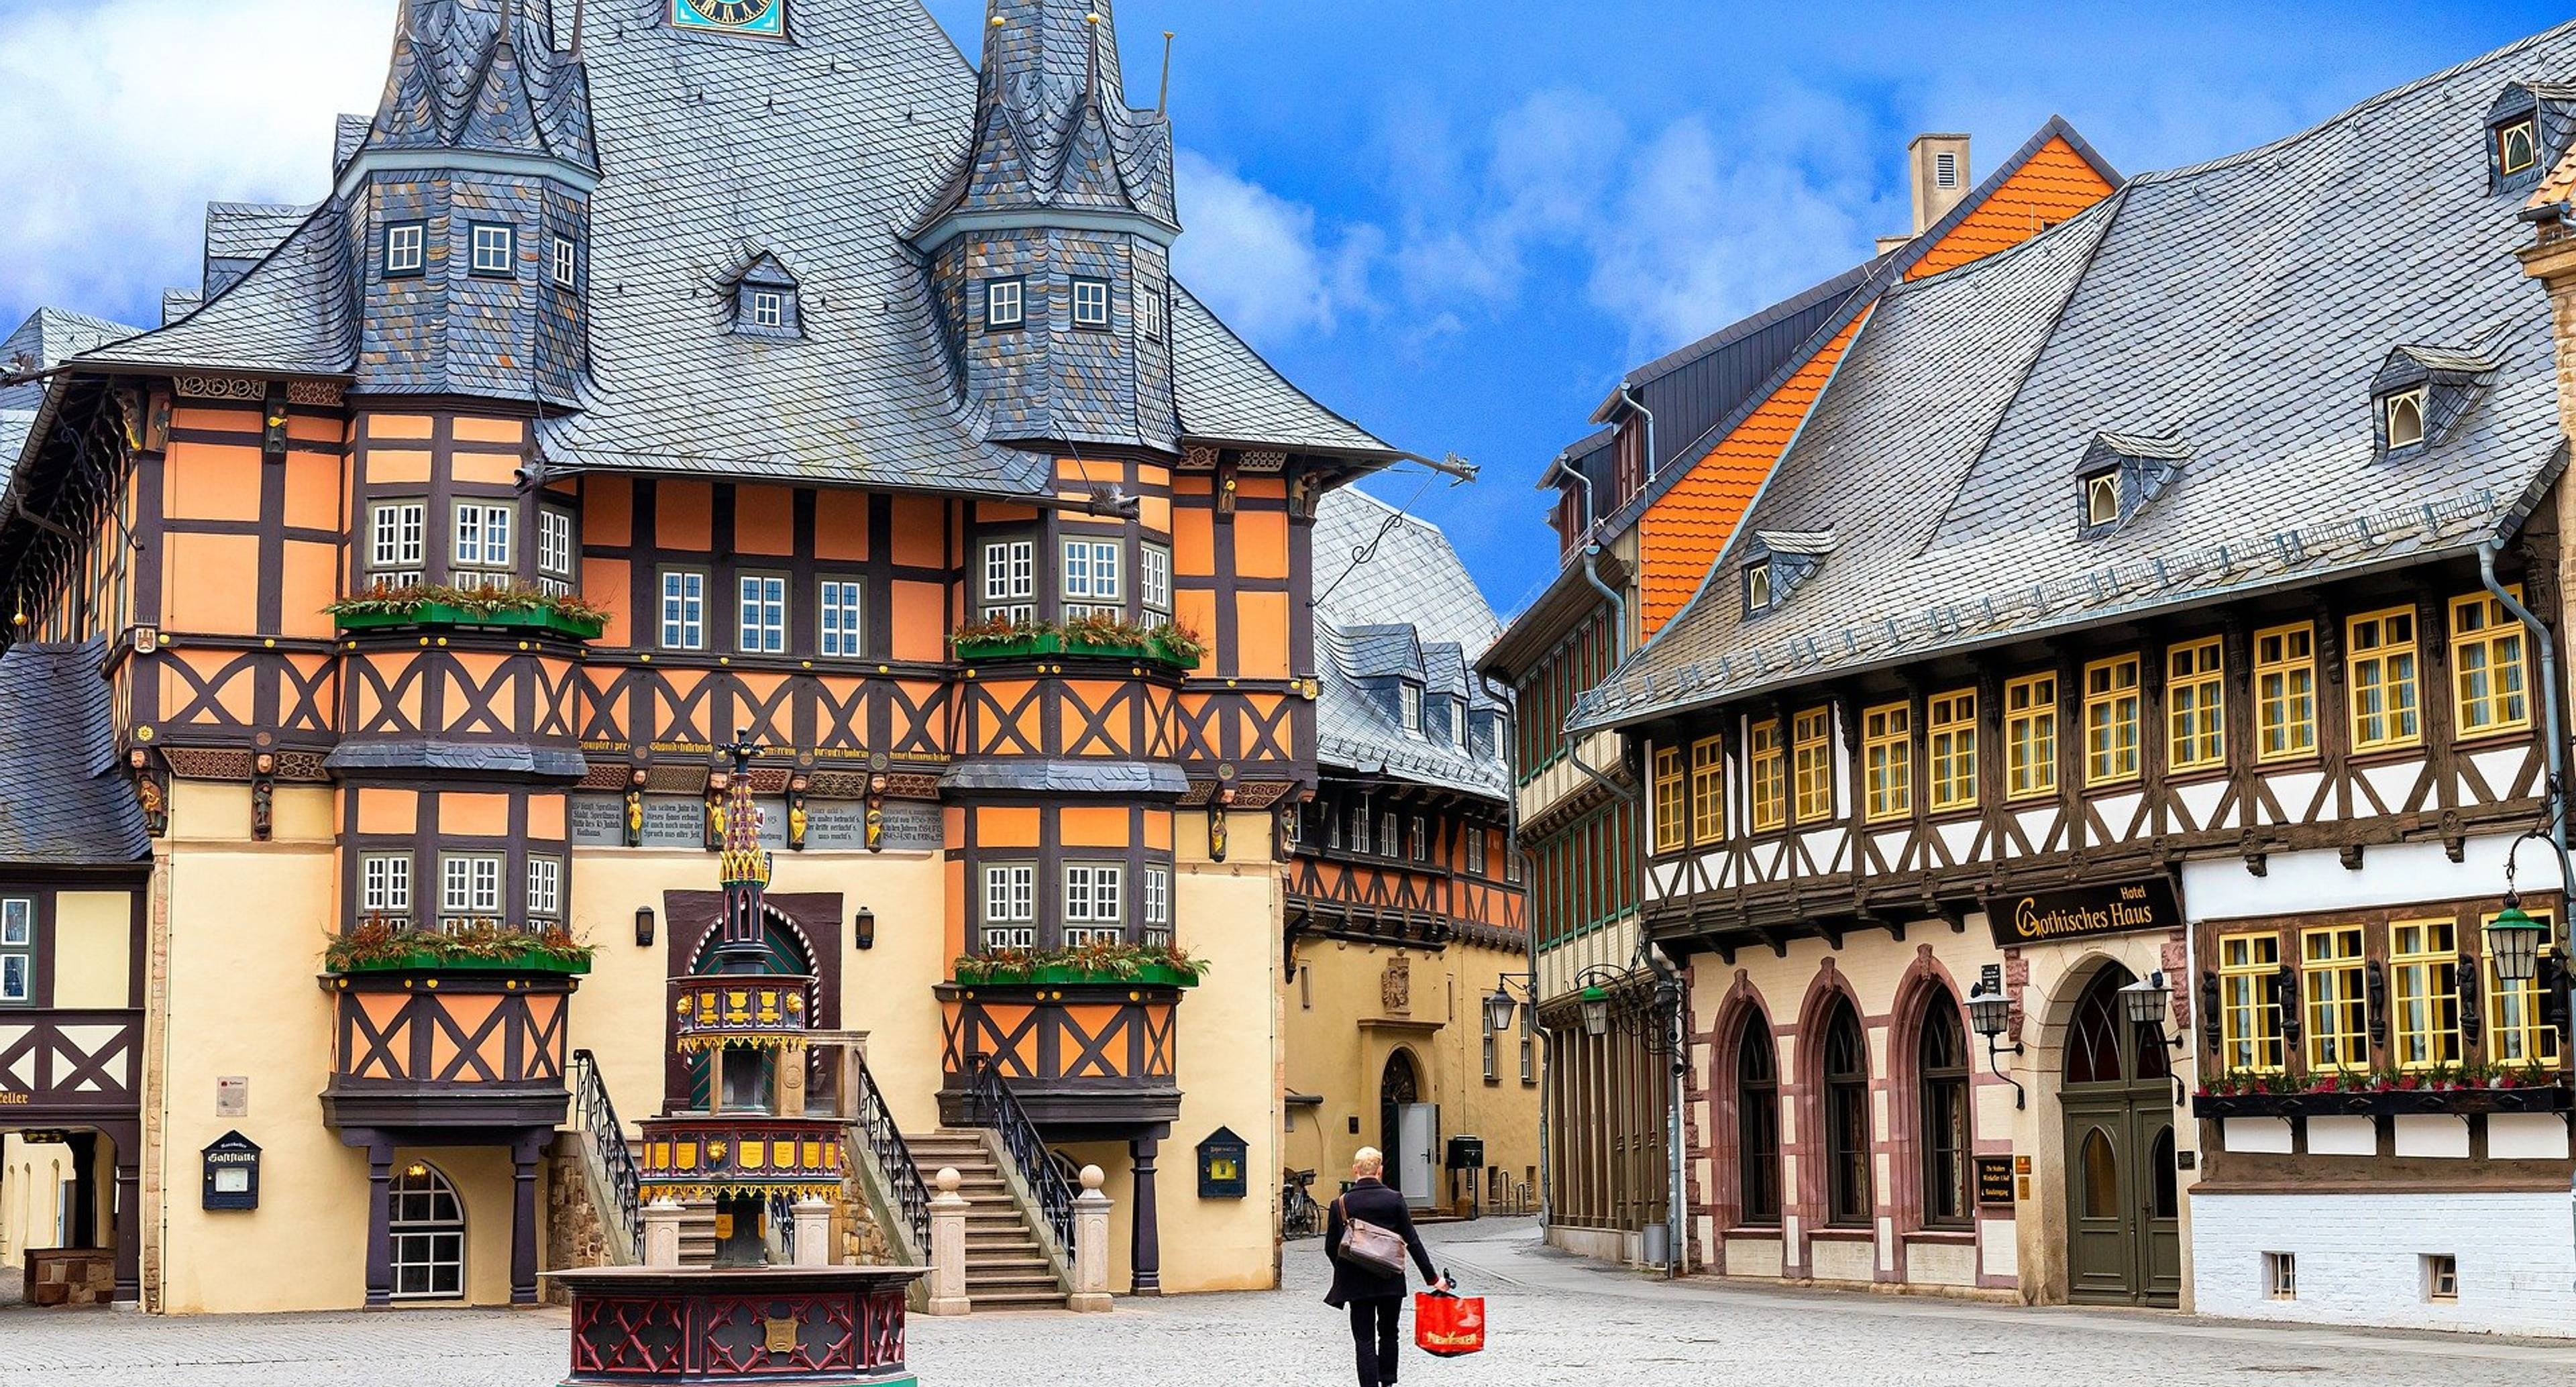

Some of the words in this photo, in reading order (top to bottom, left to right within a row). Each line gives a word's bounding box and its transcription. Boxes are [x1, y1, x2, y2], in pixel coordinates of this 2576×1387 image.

[2120, 885, 2147, 900] Hotel
[2016, 897, 2109, 938] Gothisches
[2109, 902, 2153, 927] Haus
